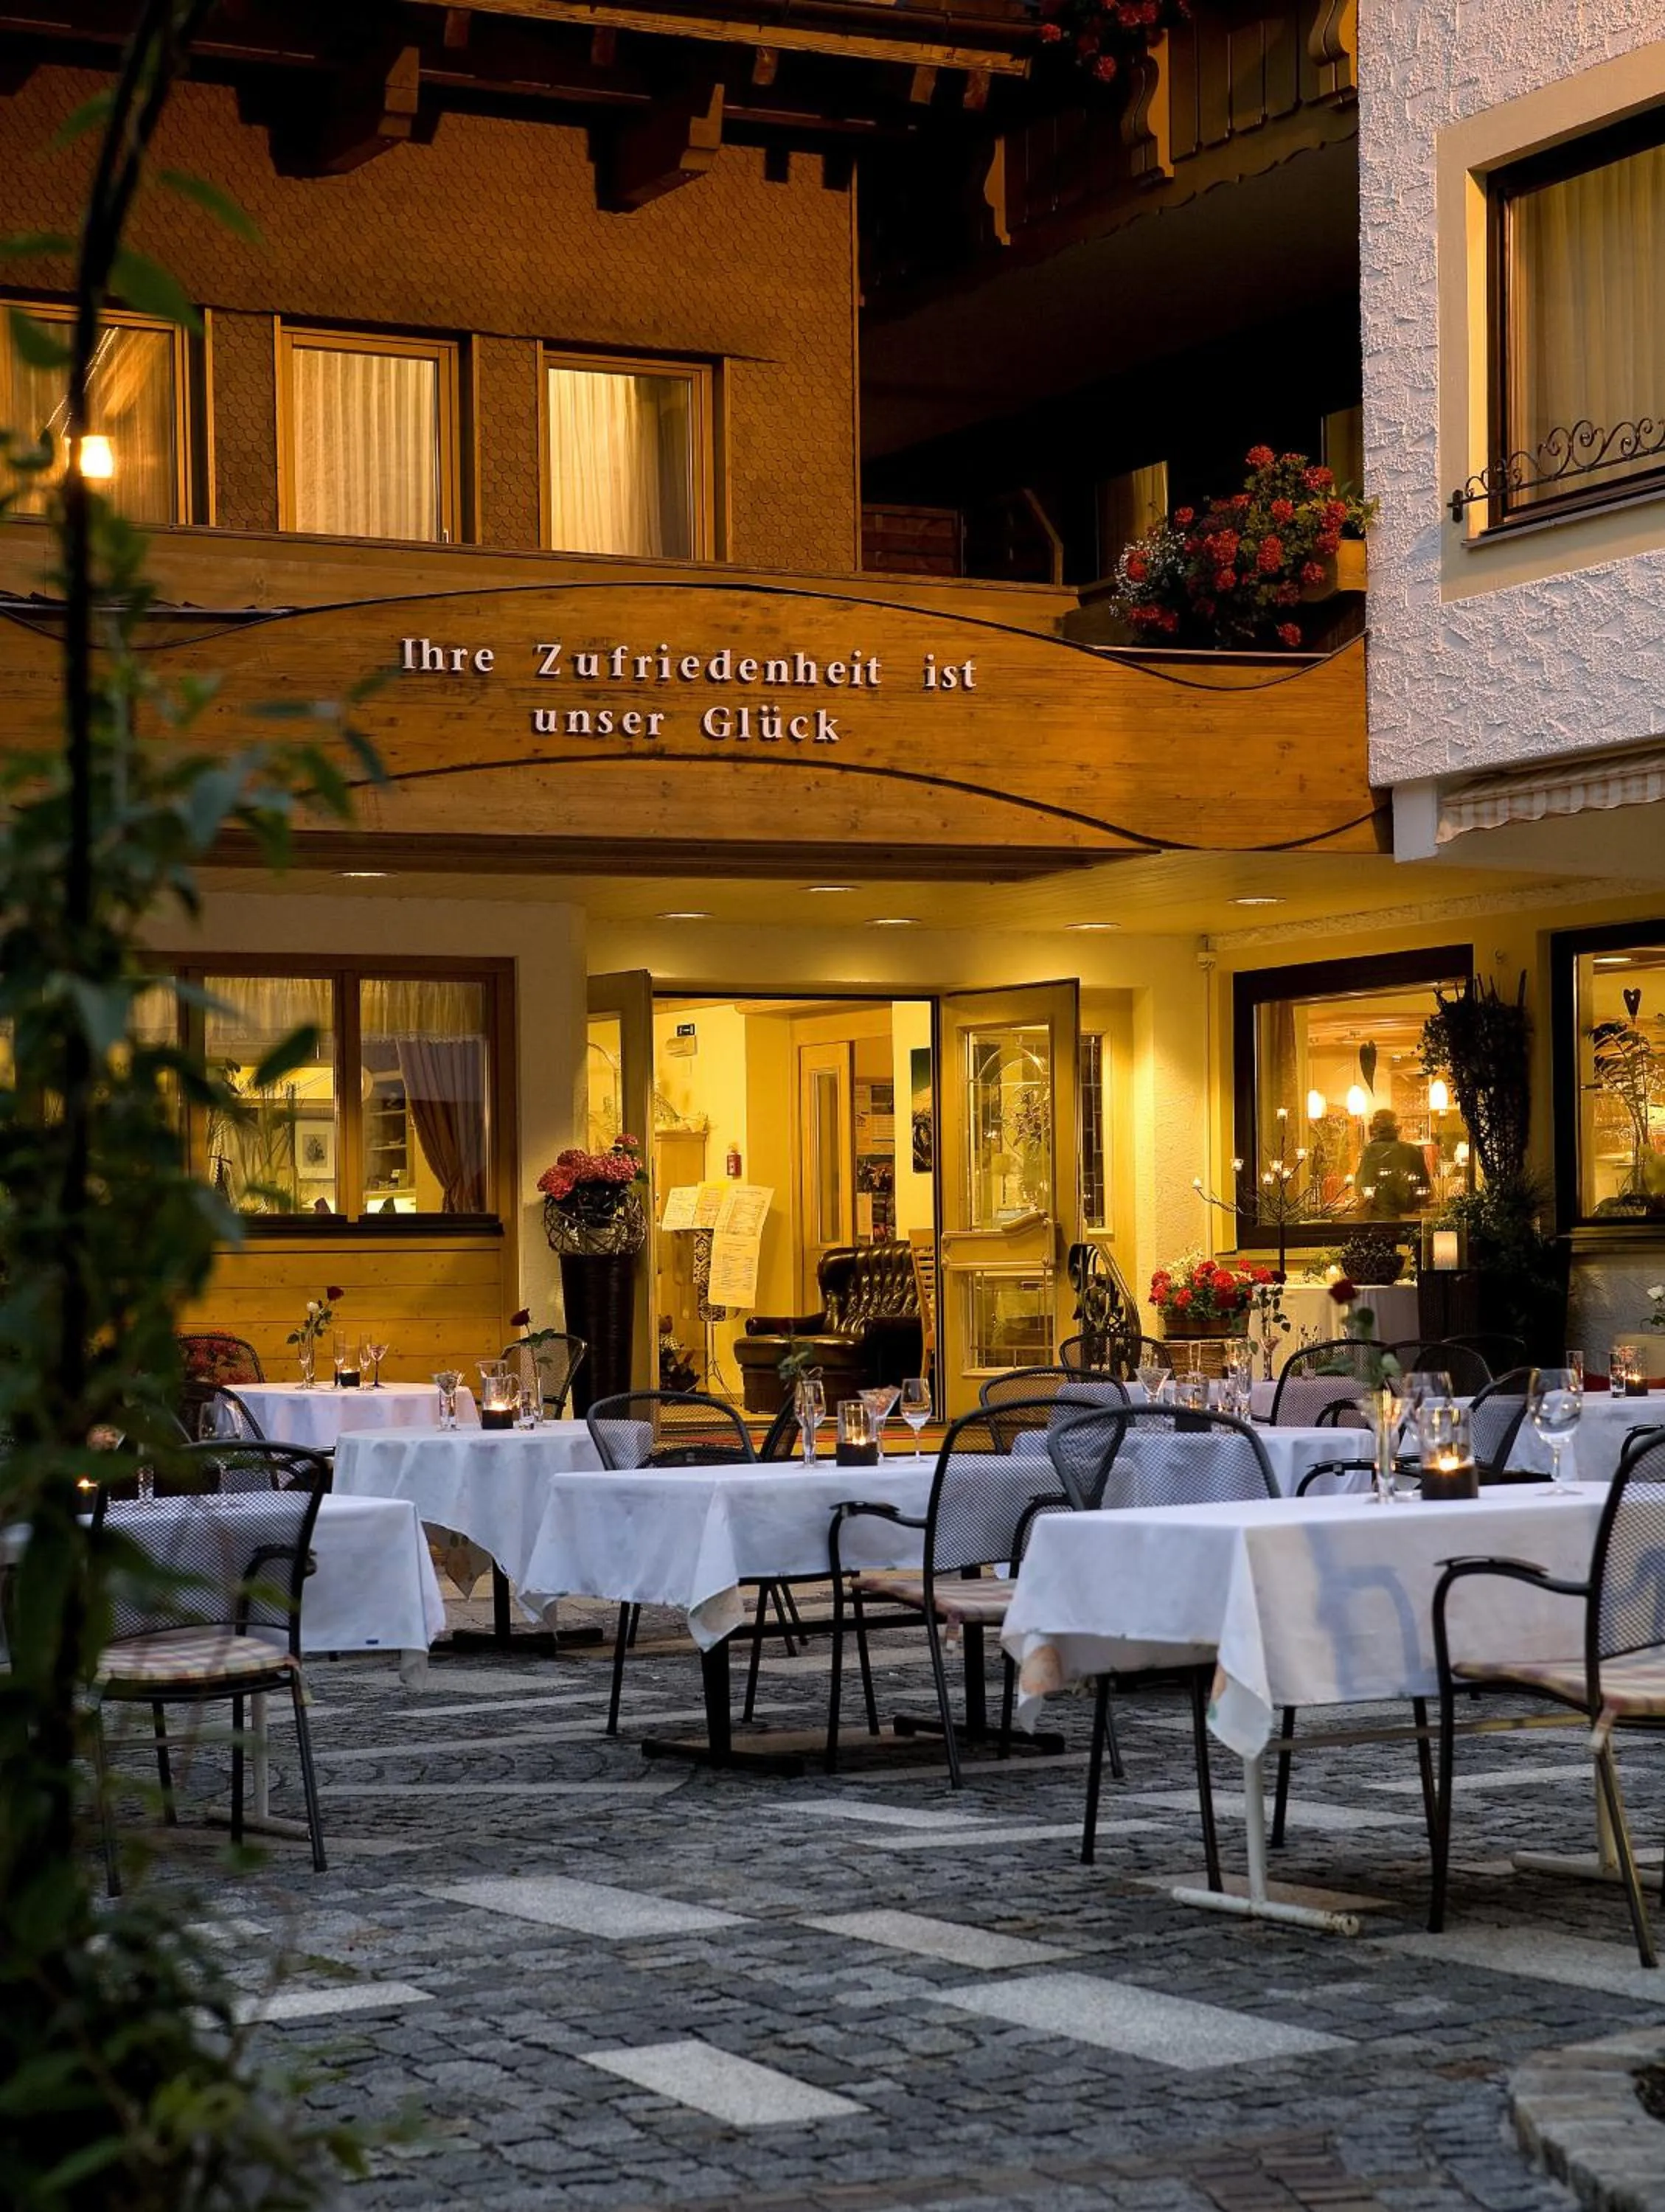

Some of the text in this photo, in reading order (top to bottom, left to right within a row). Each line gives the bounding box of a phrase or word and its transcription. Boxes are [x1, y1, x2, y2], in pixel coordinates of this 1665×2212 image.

[401, 638, 977, 689] Ihre Zufriedenheit ist
[534, 705, 840, 741] unser Glück
